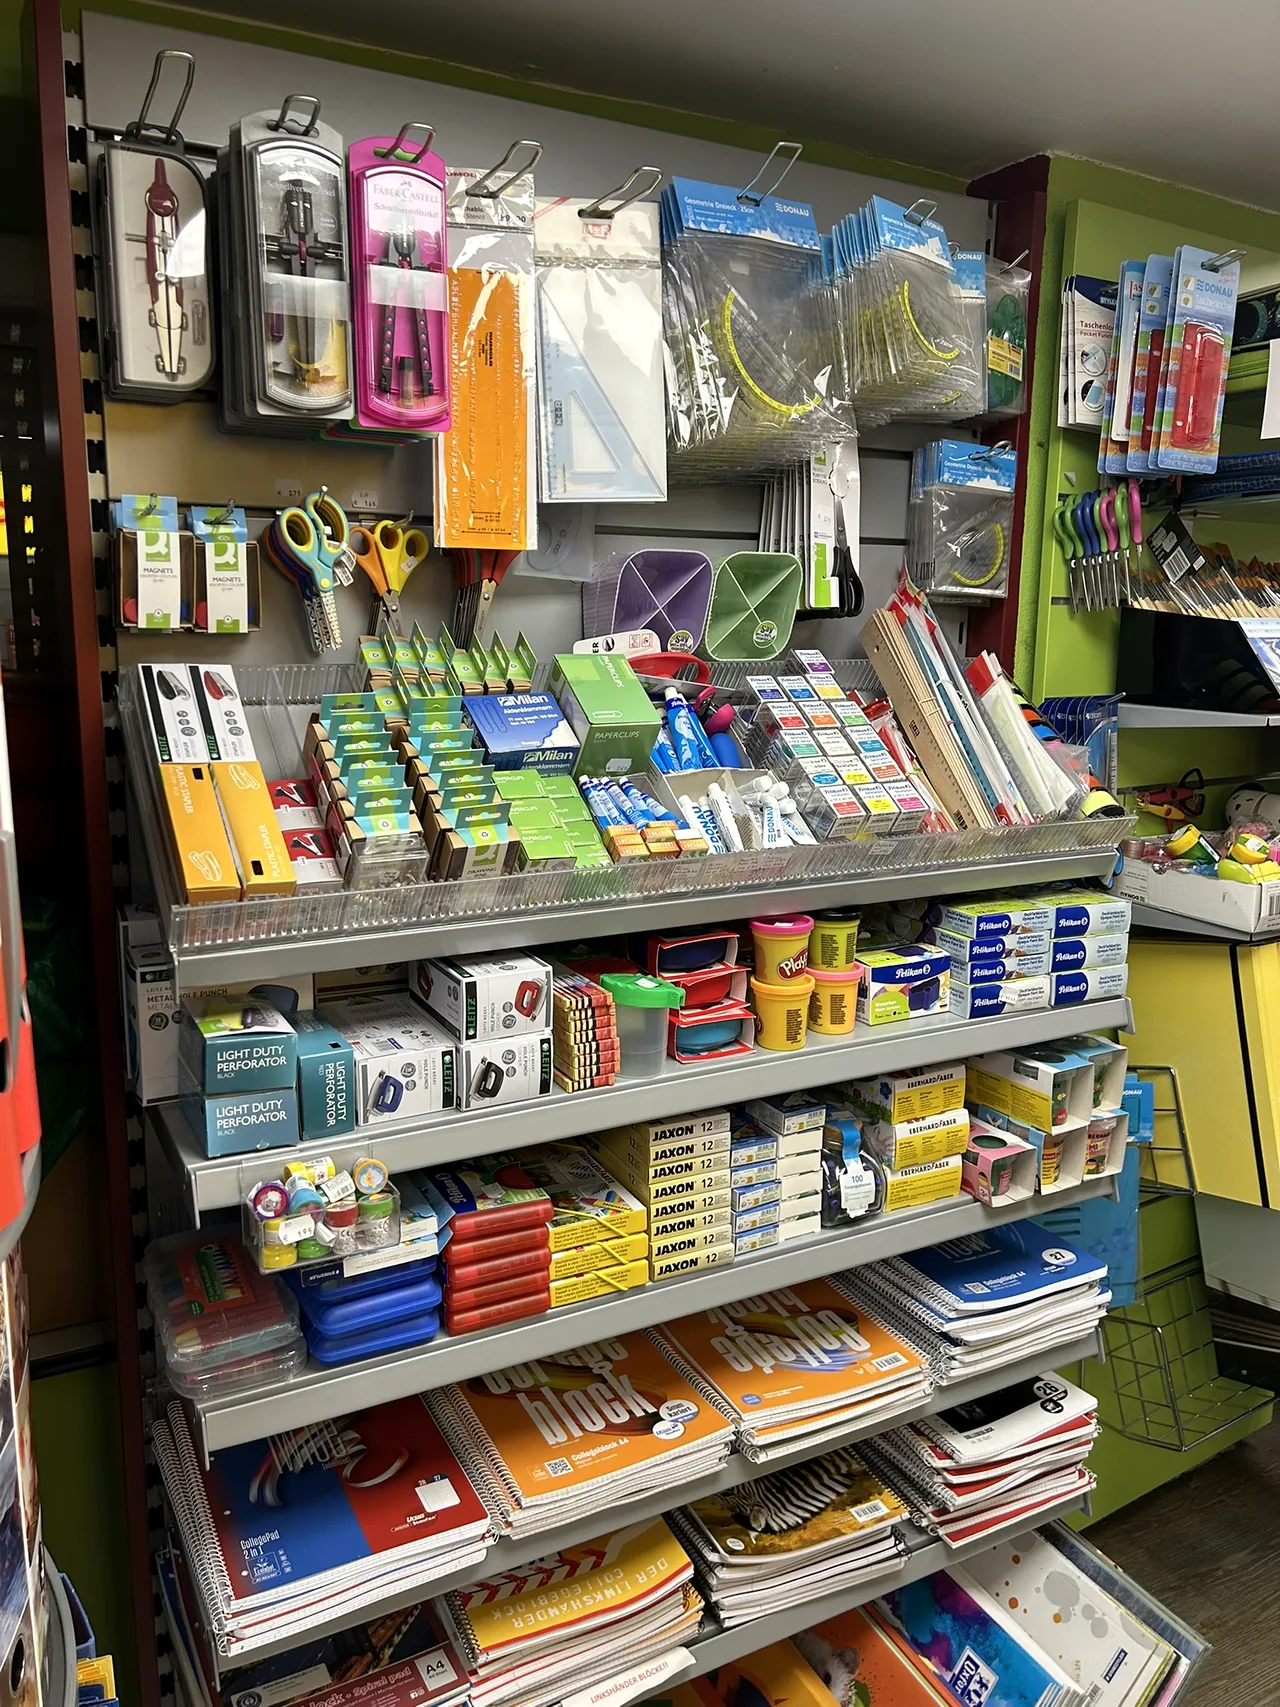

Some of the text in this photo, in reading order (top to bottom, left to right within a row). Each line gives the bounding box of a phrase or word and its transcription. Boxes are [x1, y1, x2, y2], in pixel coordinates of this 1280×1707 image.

[684, 196, 715, 209] Geometrie
[783, 206, 810, 217] DONAU
[957, 253, 982, 261] DONAU
[1205, 284, 1233, 299] DONAU
[143, 567, 174, 575] MAGNETS
[601, 655, 624, 689] PAPERCLIPS
[512, 695, 549, 706] Milan
[503, 705, 554, 715] Aktenklammern
[594, 730, 640, 740] PAPERCLIPS
[158, 736, 169, 755] LEITZ
[207, 735, 218, 754] LEITZ
[536, 750, 574, 762] Milan
[182, 788, 194, 814] STAPLER
[691, 805, 720, 844] DONAU
[259, 824, 281, 878] PLASTIC STAPLER
[467, 867, 497, 875] DRAWING
[978, 920, 1003, 931] Pelikan
[1059, 917, 1083, 928] Pelikan
[972, 944, 996, 955] Pelikan
[1055, 951, 1079, 962] Pelikan
[895, 968, 923, 979] Pelikan
[972, 967, 997, 978] Pelikan
[147, 988, 228, 1003] METAL PUNCH
[1058, 983, 1081, 994] Pelikan
[974, 997, 998, 1007] Pelikan
[467, 998, 476, 1028] LEITZ
[217, 1045, 285, 1061] LIGHT DUTY
[217, 1056, 287, 1073] PERFORATOR
[542, 1051, 550, 1080] LEITZ
[443, 1064, 453, 1094] LEITZ
[325, 1063, 337, 1128] PERFORATOR
[336, 1061, 347, 1121] LIGHT DUTY
[1122, 1088, 1143, 1096] ONAU
[216, 1099, 283, 1118] LIGHT DUTY
[216, 1110, 288, 1130] PERFORATOR
[217, 1128, 236, 1136] BLACK
[652, 1121, 713, 1142] JAXON 12
[629, 1136, 636, 1149] 12
[653, 1141, 713, 1161] JAXON 12
[628, 1153, 635, 1166] 12
[651, 1158, 713, 1179] JAXON 12
[628, 1173, 636, 1184] 12
[851, 1175, 864, 1183] 100
[653, 1178, 713, 1199] JAXON 12
[653, 1197, 714, 1218] JAXON 12
[654, 1214, 714, 1236] JAXON 12
[655, 1234, 715, 1256] JAXON 12
[657, 1252, 718, 1276] JAXON 12
[1050, 1251, 1066, 1261] 27
[710, 1310, 872, 1375] college
[1035, 1381, 1060, 1397] 26
[516, 1375, 658, 1446] block
[665, 1402, 684, 1412] 5mm
[668, 1406, 692, 1418] kariert
[571, 1437, 630, 1462] Collegeblock A4
[240, 1529, 280, 1550] CollegePad
[243, 1545, 263, 1560] 2 in 1
[493, 1568, 625, 1620] COLLEGEBLOCK
[512, 1557, 670, 1629] DER LINKSHÄNDER
[425, 1659, 446, 1676] A4
[352, 1678, 388, 1697] Spiral
[389, 1666, 413, 1685] pad
[590, 1661, 670, 1705] LINKSHÄNDER BLÖCKE!!
